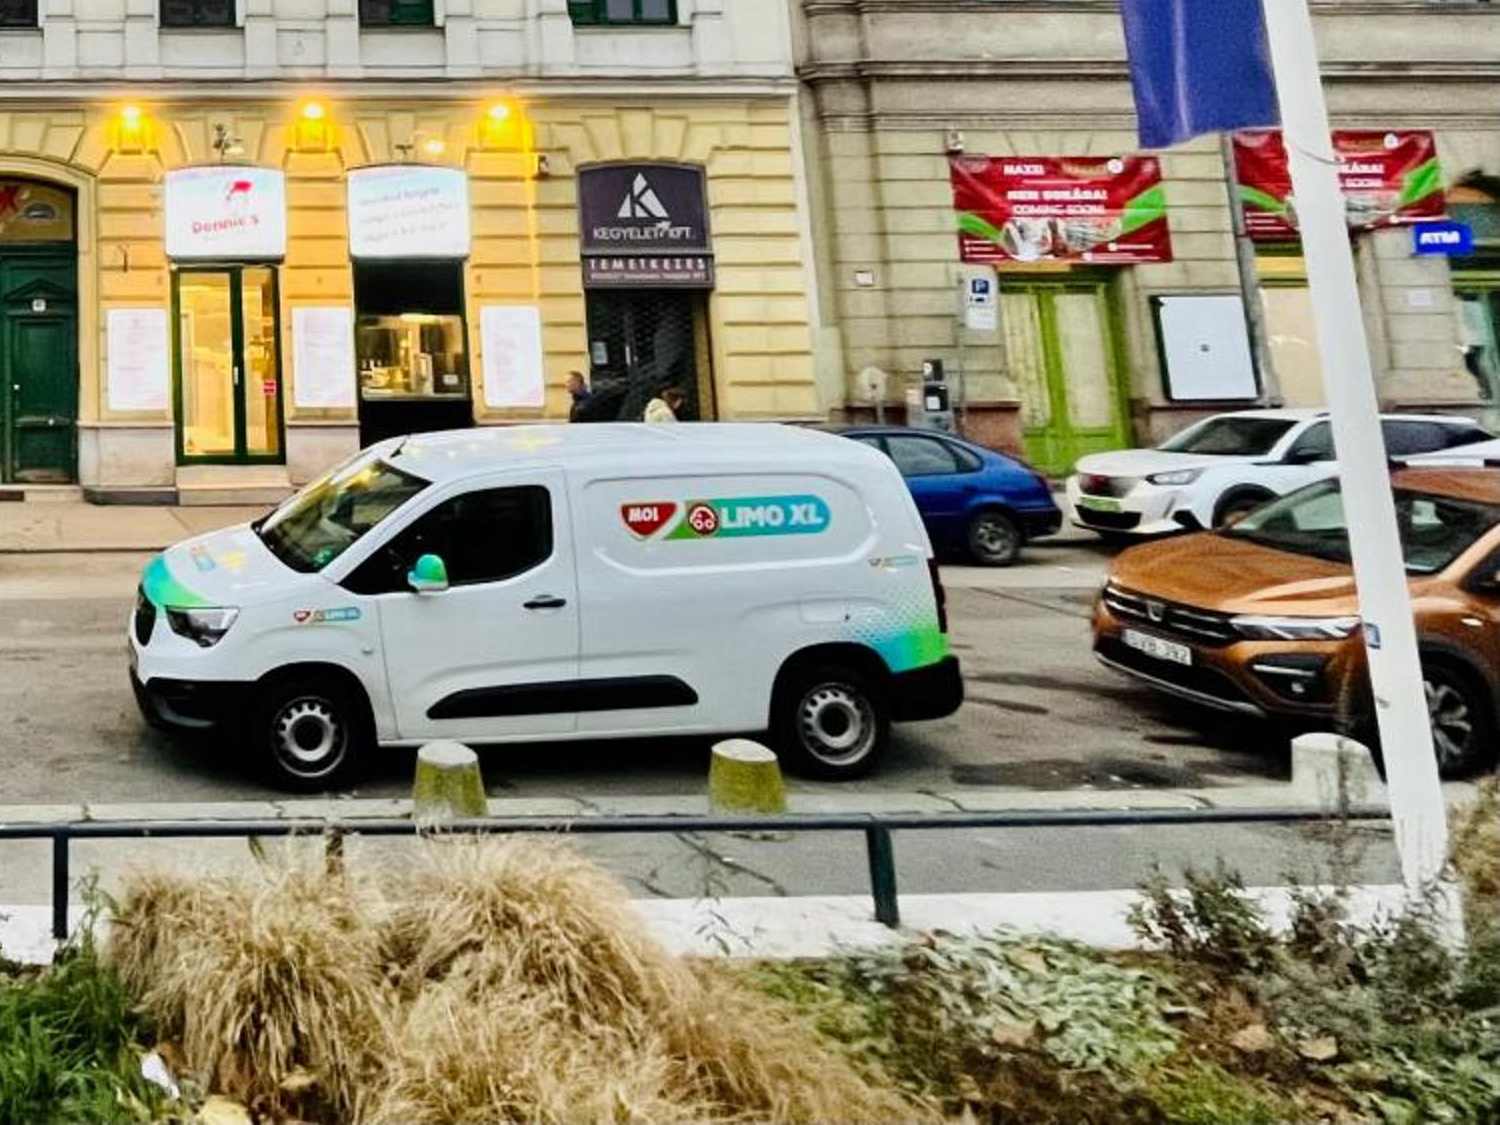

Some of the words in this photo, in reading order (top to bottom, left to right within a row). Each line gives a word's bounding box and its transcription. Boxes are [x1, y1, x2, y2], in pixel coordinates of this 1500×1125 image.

[593, 226, 660, 240] KEGYELET
[1420, 231, 1460, 244] ATM
[721, 505, 785, 528] LIMO
[789, 503, 825, 525] XL
